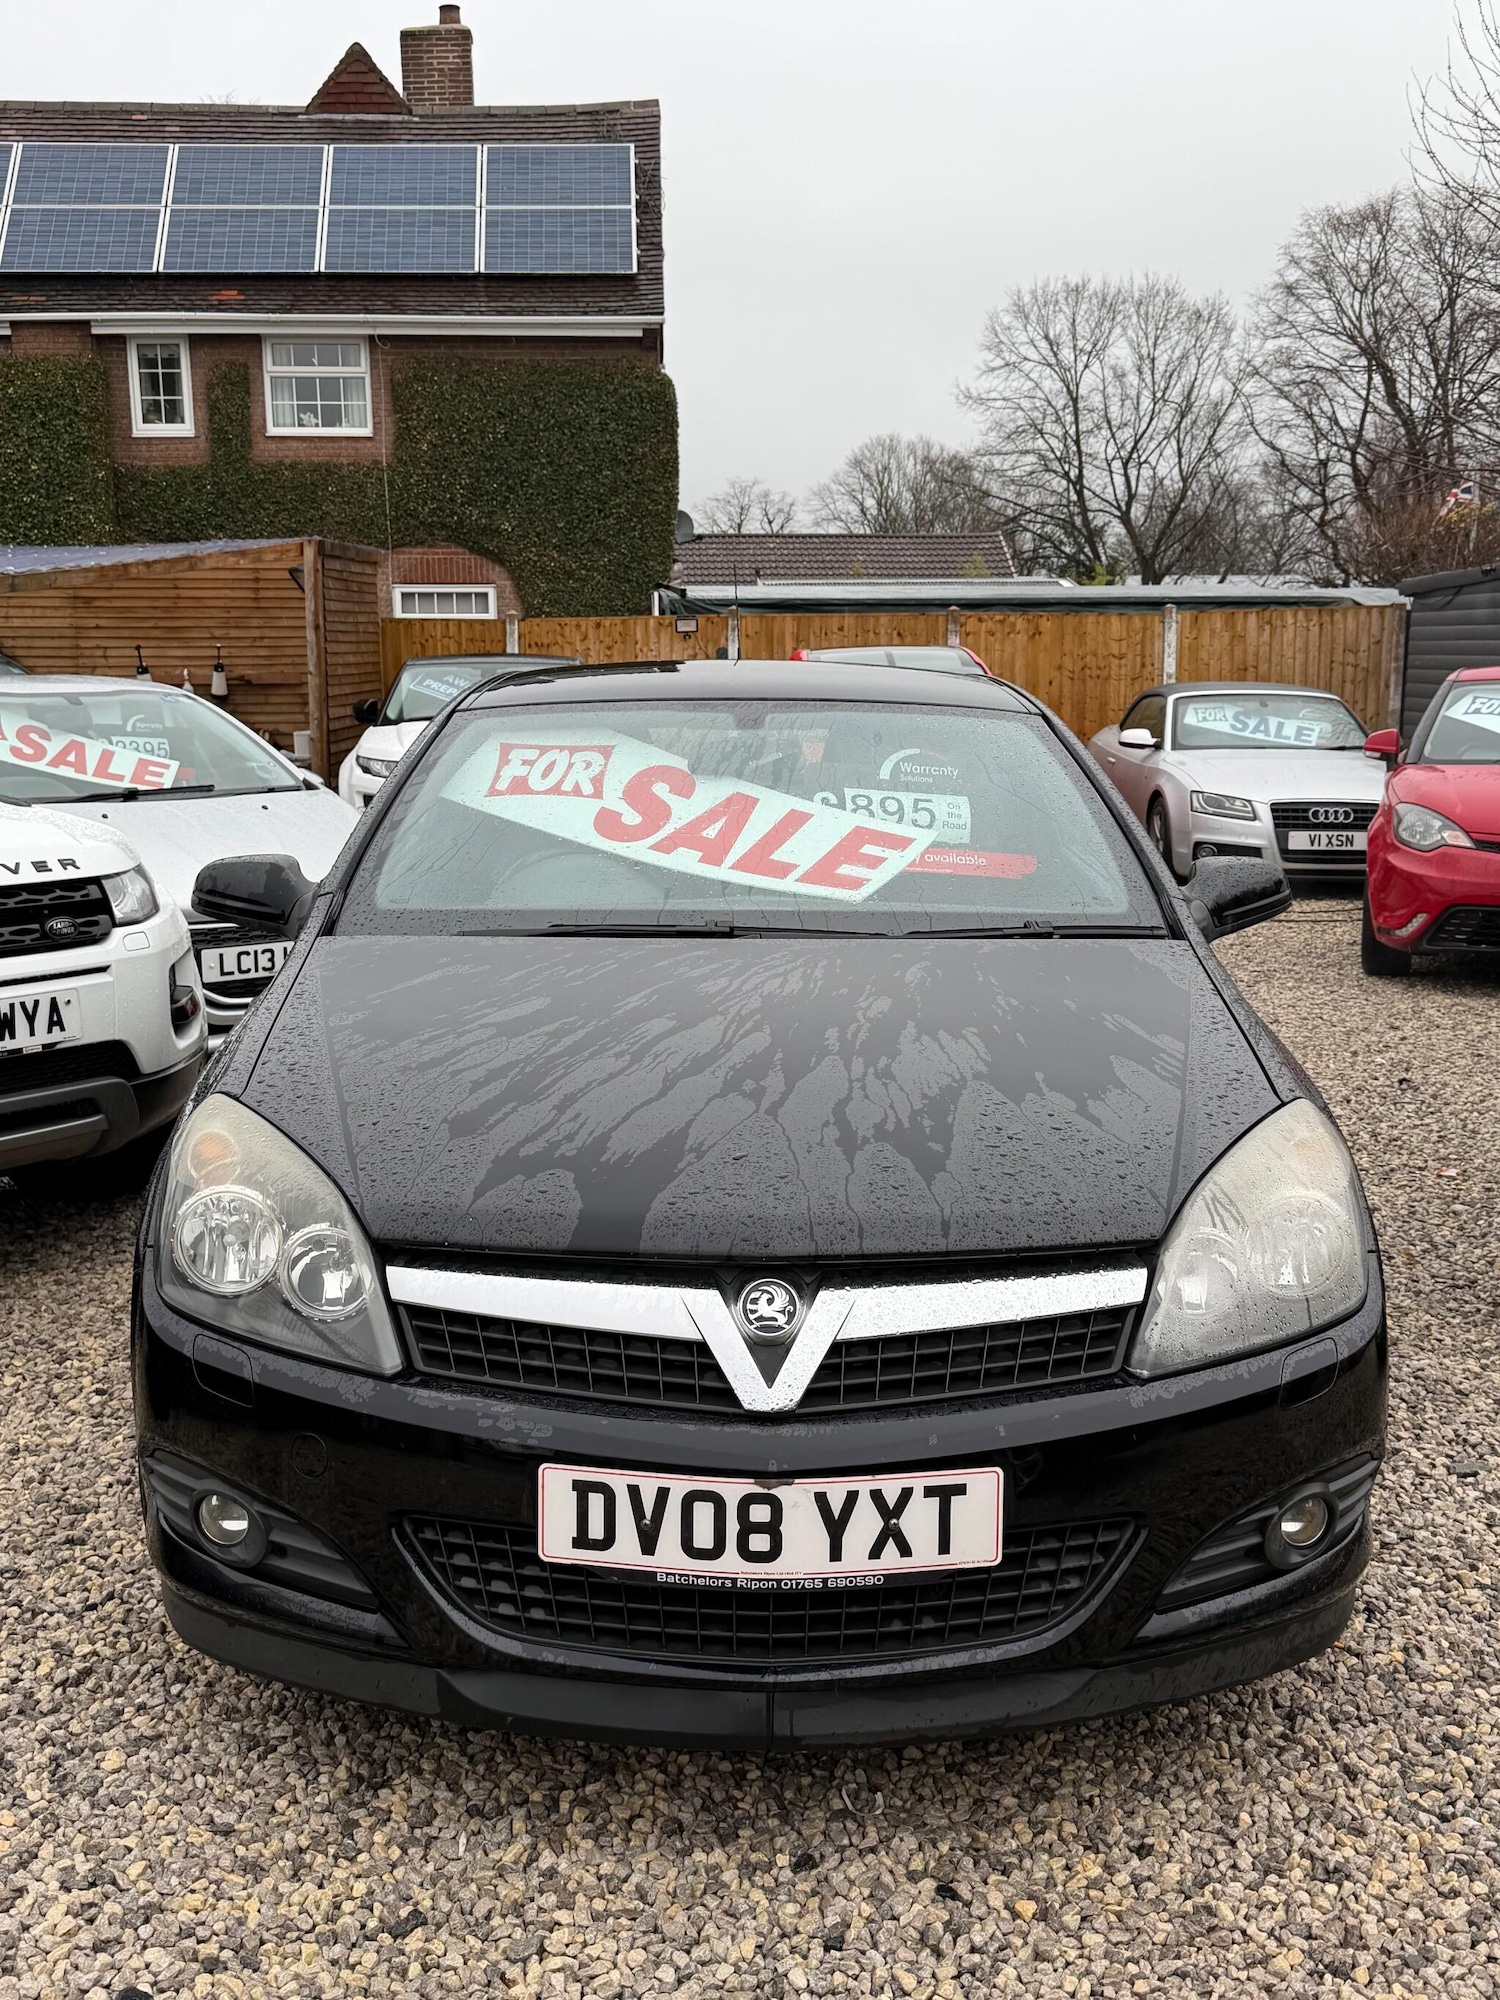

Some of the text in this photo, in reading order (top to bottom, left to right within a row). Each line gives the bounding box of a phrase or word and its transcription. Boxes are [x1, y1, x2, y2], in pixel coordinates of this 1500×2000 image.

[1197, 709, 1226, 722] FOR
[1229, 710, 1316, 745] SALE
[10, 724, 171, 790] SALE
[900, 762, 959, 778] Warranty
[900, 774, 933, 784] Solutions
[495, 748, 917, 893] FOR SALE
[948, 812, 962, 820] the
[943, 821, 967, 831] Road
[1326, 834, 1354, 848] XSN
[924, 853, 987, 866] available
[219, 948, 276, 977] LC13
[0, 996, 66, 1042] WYA
[571, 1479, 967, 1564] DV08 YXT
[656, 1571, 884, 1590] Batchelors Ripon 01765 690590
